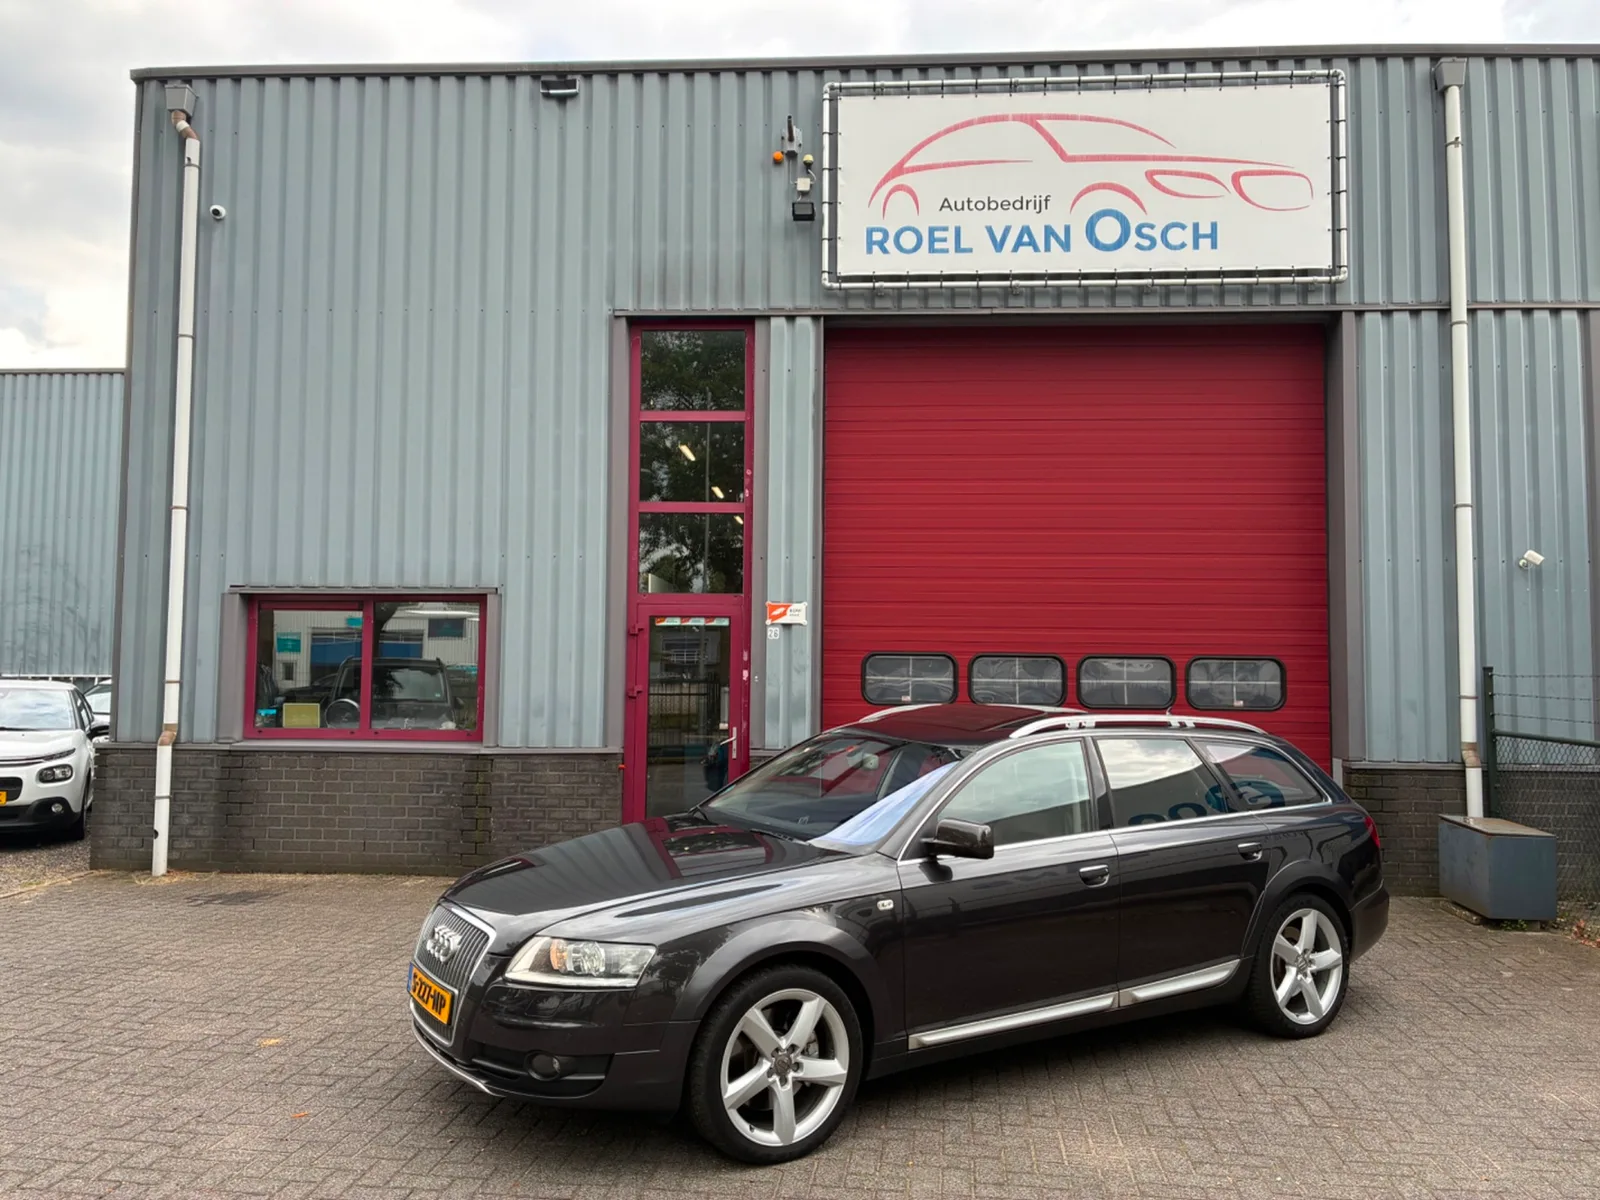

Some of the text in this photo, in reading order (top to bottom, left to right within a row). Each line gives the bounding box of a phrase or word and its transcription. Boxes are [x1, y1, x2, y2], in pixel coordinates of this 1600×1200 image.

[939, 195, 1051, 214] Autobedrijf
[866, 209, 1219, 255] ROEL VAN OSCH
[768, 628, 779, 639] 26
